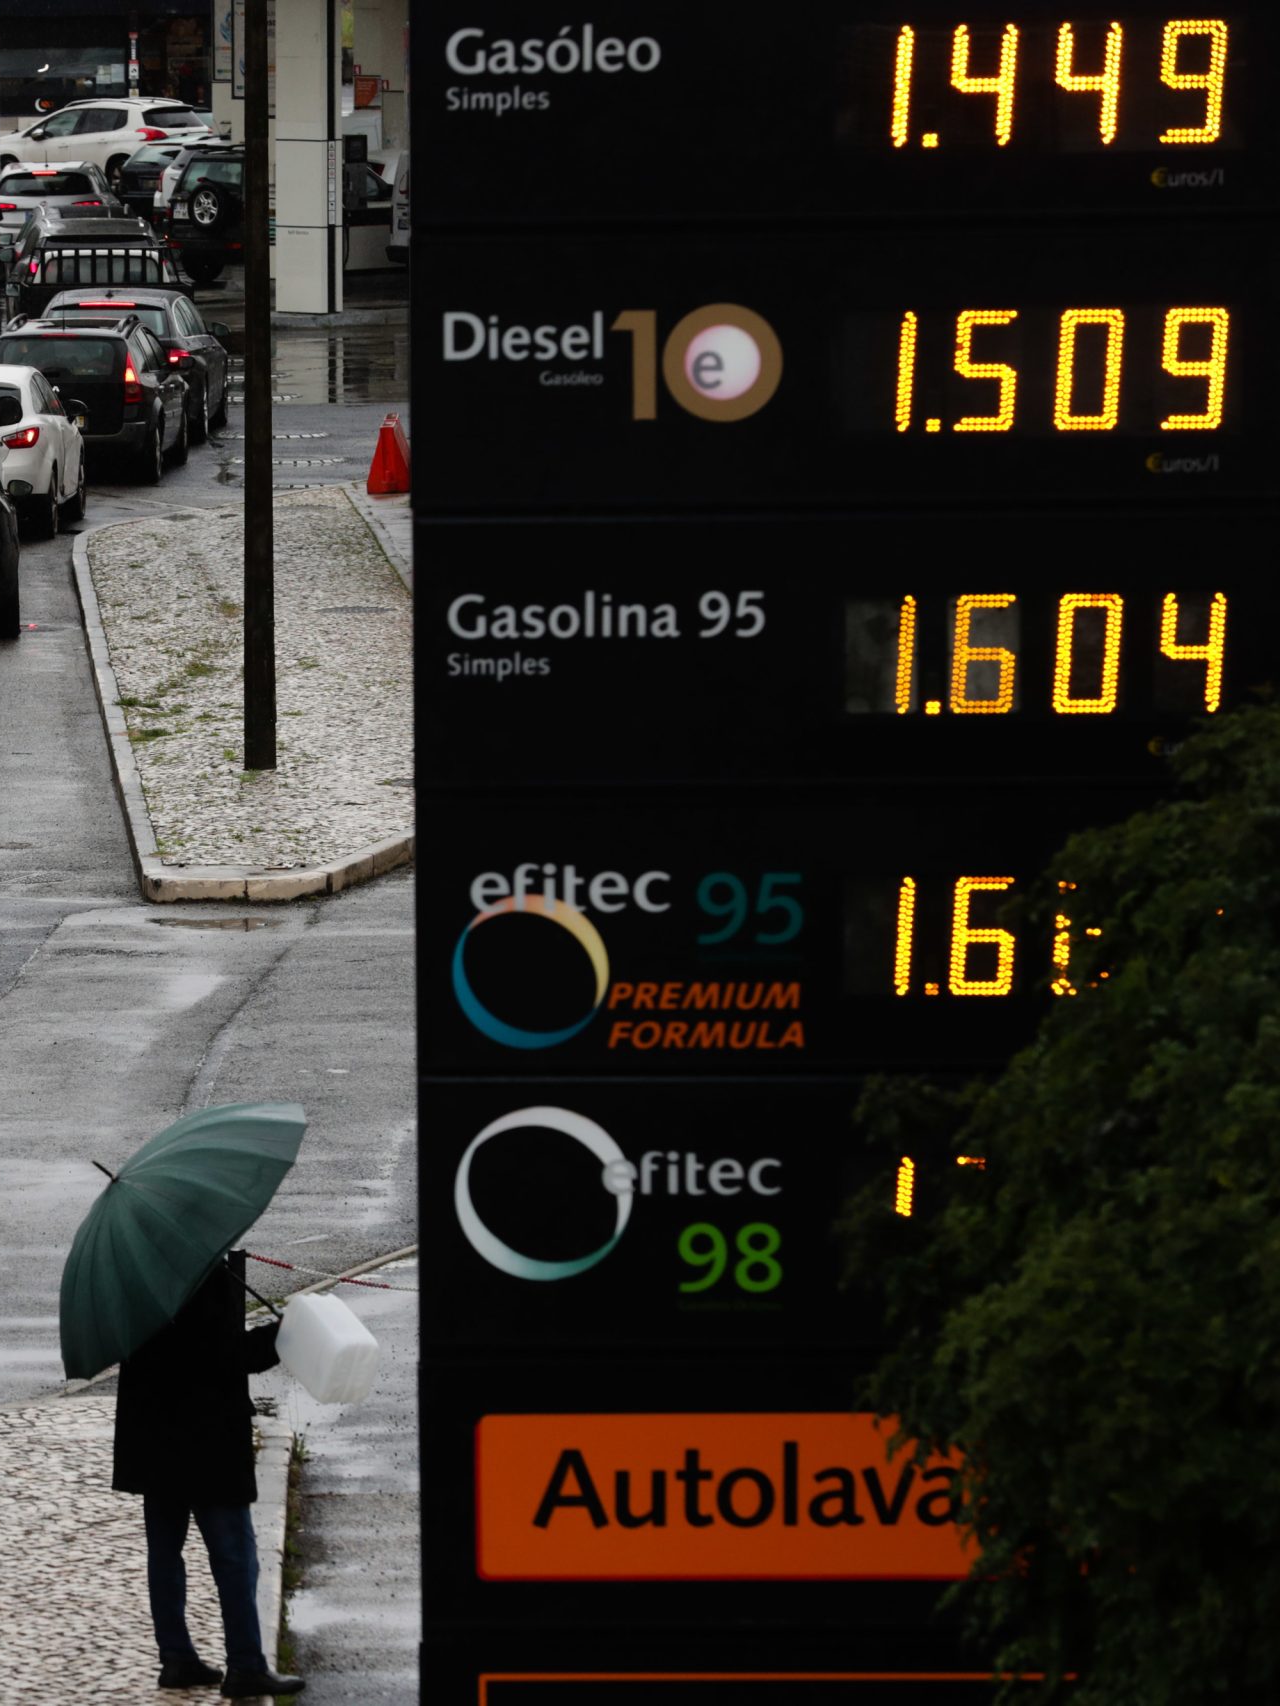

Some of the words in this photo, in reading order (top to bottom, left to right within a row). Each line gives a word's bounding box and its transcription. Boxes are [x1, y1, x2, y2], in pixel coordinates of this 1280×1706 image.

[445, 23, 662, 75] Gasóleo
[446, 86, 550, 117] Simples
[890, 19, 1231, 150] 1.449
[443, 310, 604, 361] Diesel
[691, 350, 724, 390] e
[893, 306, 1231, 433] 1.509
[447, 590, 681, 639] Gasolina
[698, 590, 766, 638] 95
[447, 652, 551, 682] Simples
[893, 592, 1228, 715] 1.604
[470, 862, 671, 913] efitec
[695, 872, 803, 945] 95
[607, 981, 801, 1010] PREMIUM
[608, 1021, 805, 1049] FORMULA
[602, 1151, 782, 1197] efitec
[677, 1222, 783, 1293] 98
